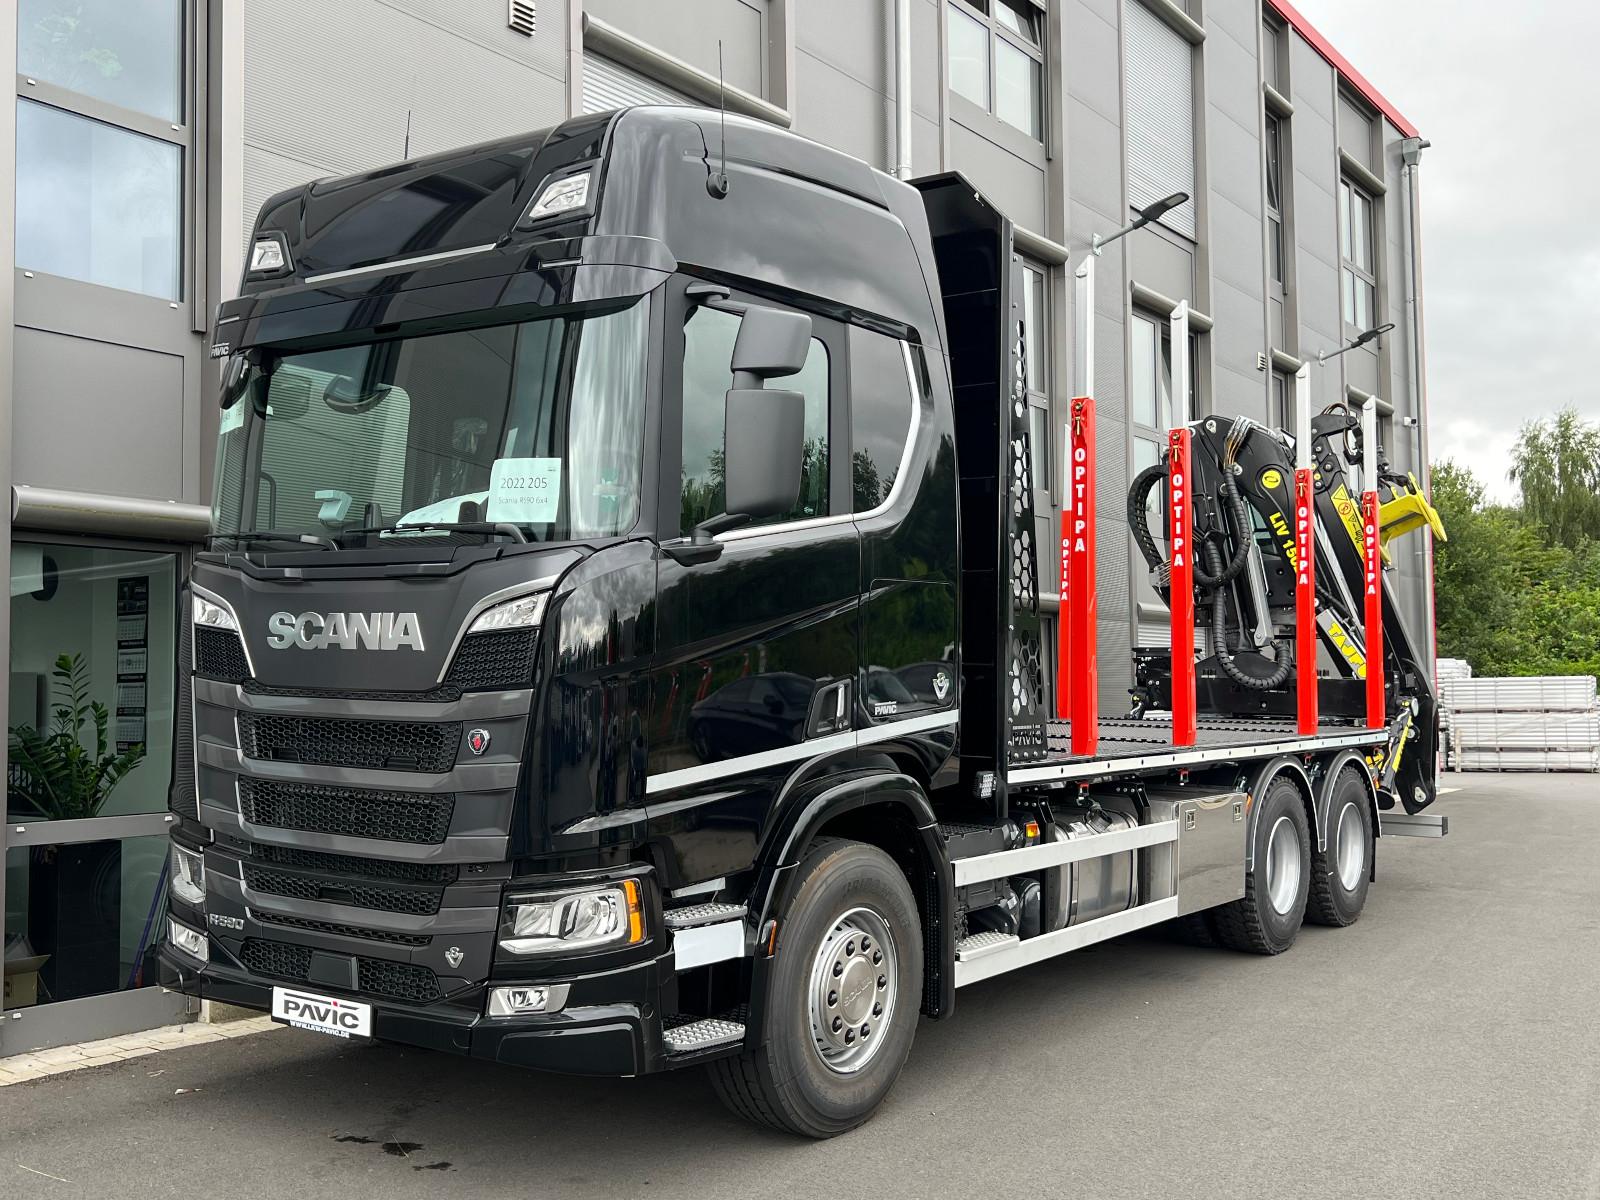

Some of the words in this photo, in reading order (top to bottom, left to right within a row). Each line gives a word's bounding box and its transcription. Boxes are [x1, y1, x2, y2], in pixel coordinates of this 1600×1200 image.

[501, 478, 525, 488] 2022
[528, 478, 548, 488] 205
[1074, 448, 1085, 552] OPTIPA
[1172, 474, 1184, 567] OPTIPA
[1269, 511, 1290, 536] LIV
[1298, 507, 1309, 585] OPTIPA
[1365, 525, 1376, 595] OPTIPA
[1061, 539, 1070, 601] OPTIPA
[266, 611, 425, 652] SCANIA
[874, 704, 897, 716] PAVIC
[1012, 730, 1042, 746] PAVIC
[210, 913, 244, 930] R590
[283, 999, 360, 1030] PAVIC
